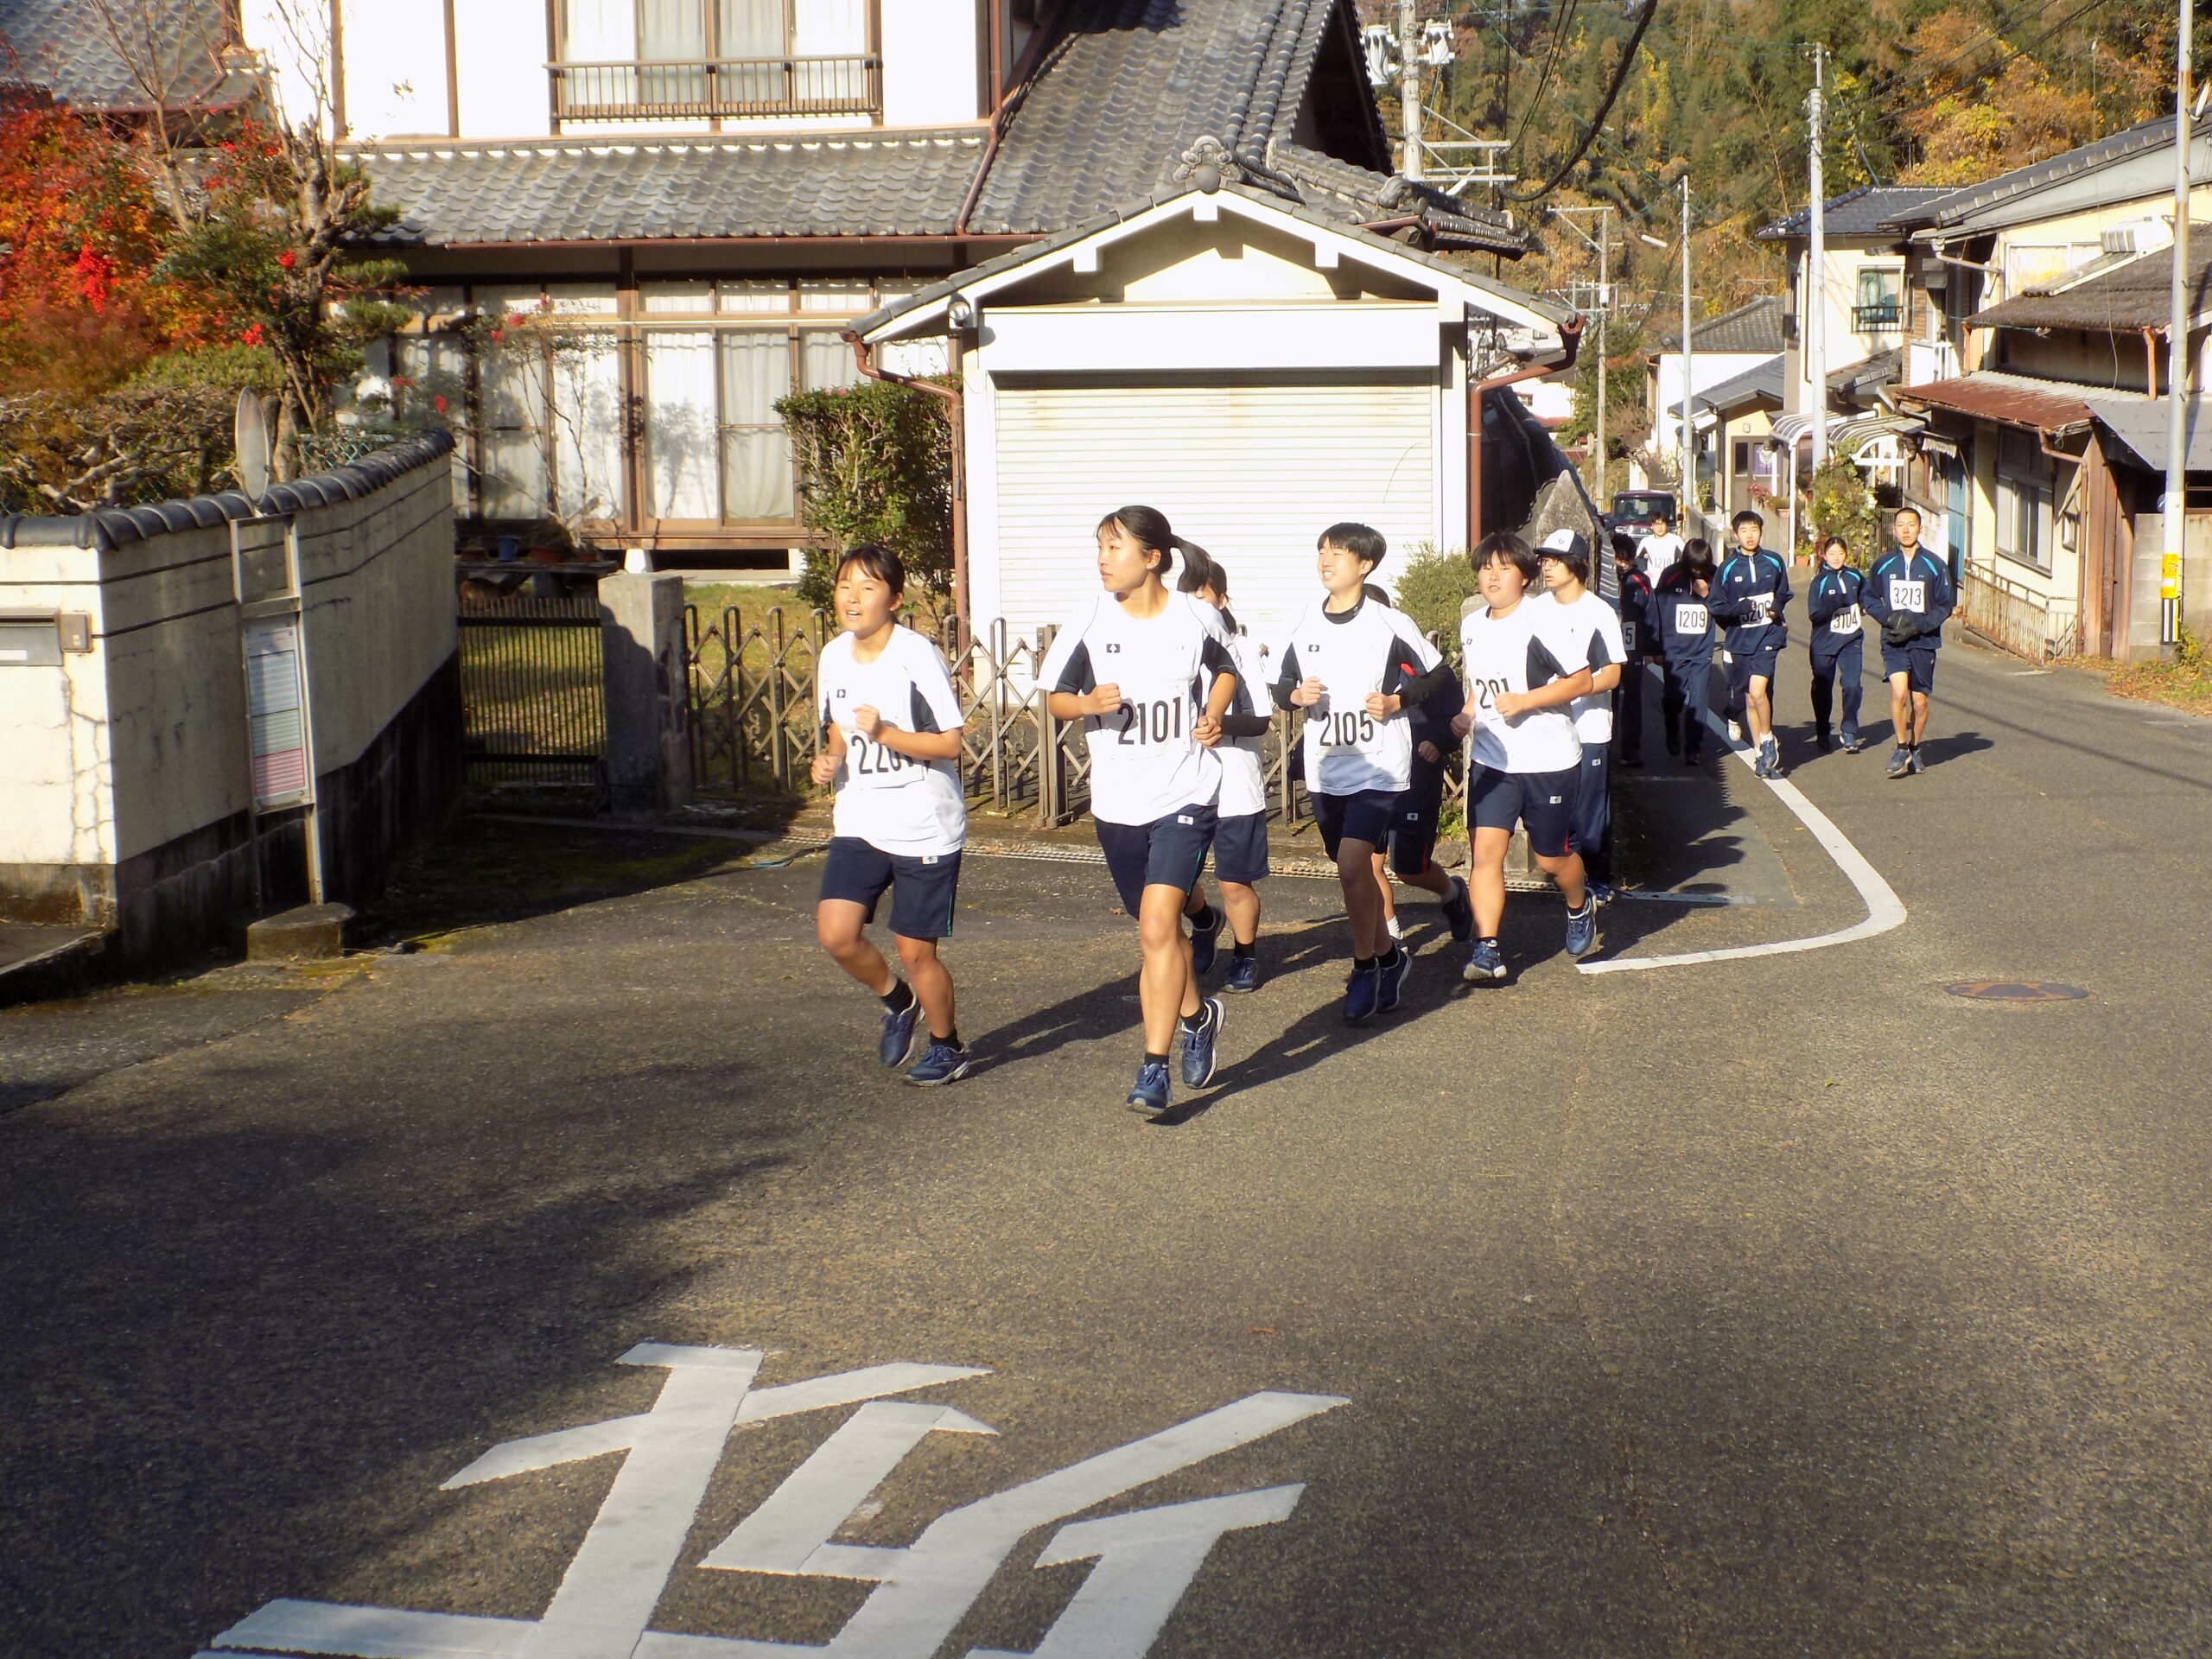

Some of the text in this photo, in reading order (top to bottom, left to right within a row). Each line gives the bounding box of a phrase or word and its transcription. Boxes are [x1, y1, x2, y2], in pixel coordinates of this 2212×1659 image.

[1893, 588, 1921, 606] 3213
[1679, 610, 1707, 628] 1209
[1831, 607, 1858, 629] 3104
[1117, 696, 1181, 745] 2101
[1319, 709, 1374, 746] 2105
[850, 734, 914, 775] 220
